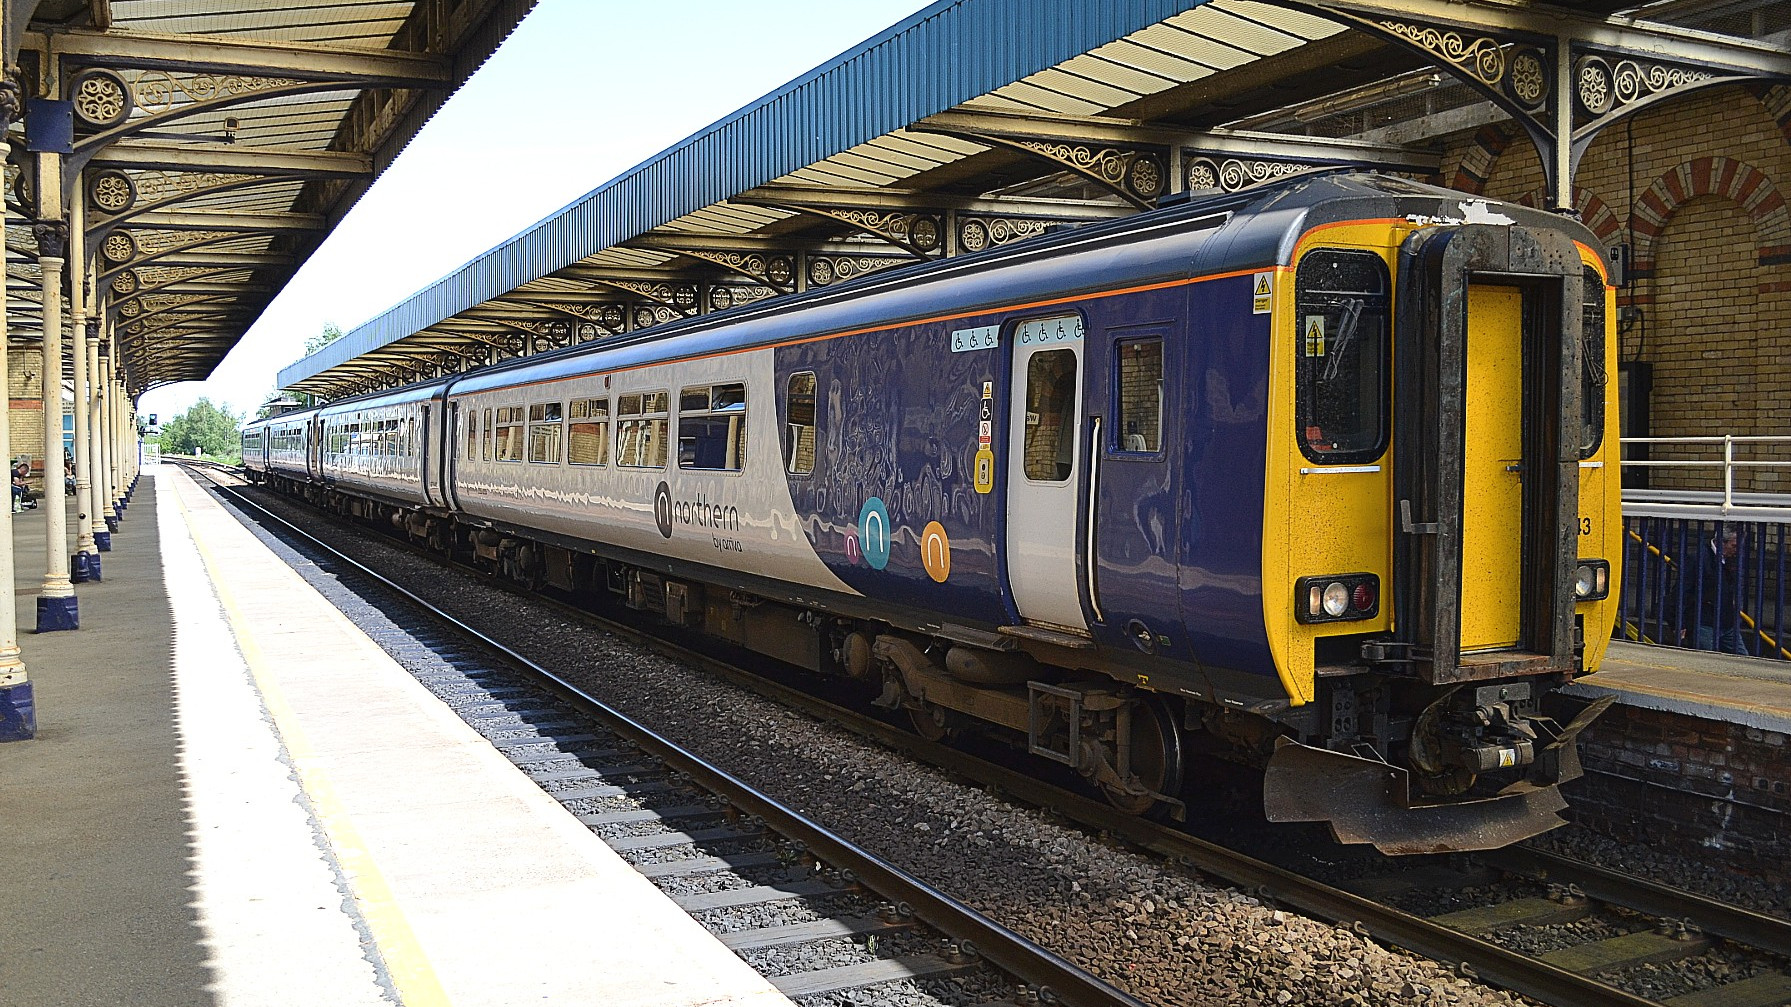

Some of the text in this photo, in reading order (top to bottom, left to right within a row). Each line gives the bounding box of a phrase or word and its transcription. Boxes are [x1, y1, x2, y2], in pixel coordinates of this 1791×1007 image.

[674, 493, 739, 531] northern
[711, 532, 743, 553] by arriva
